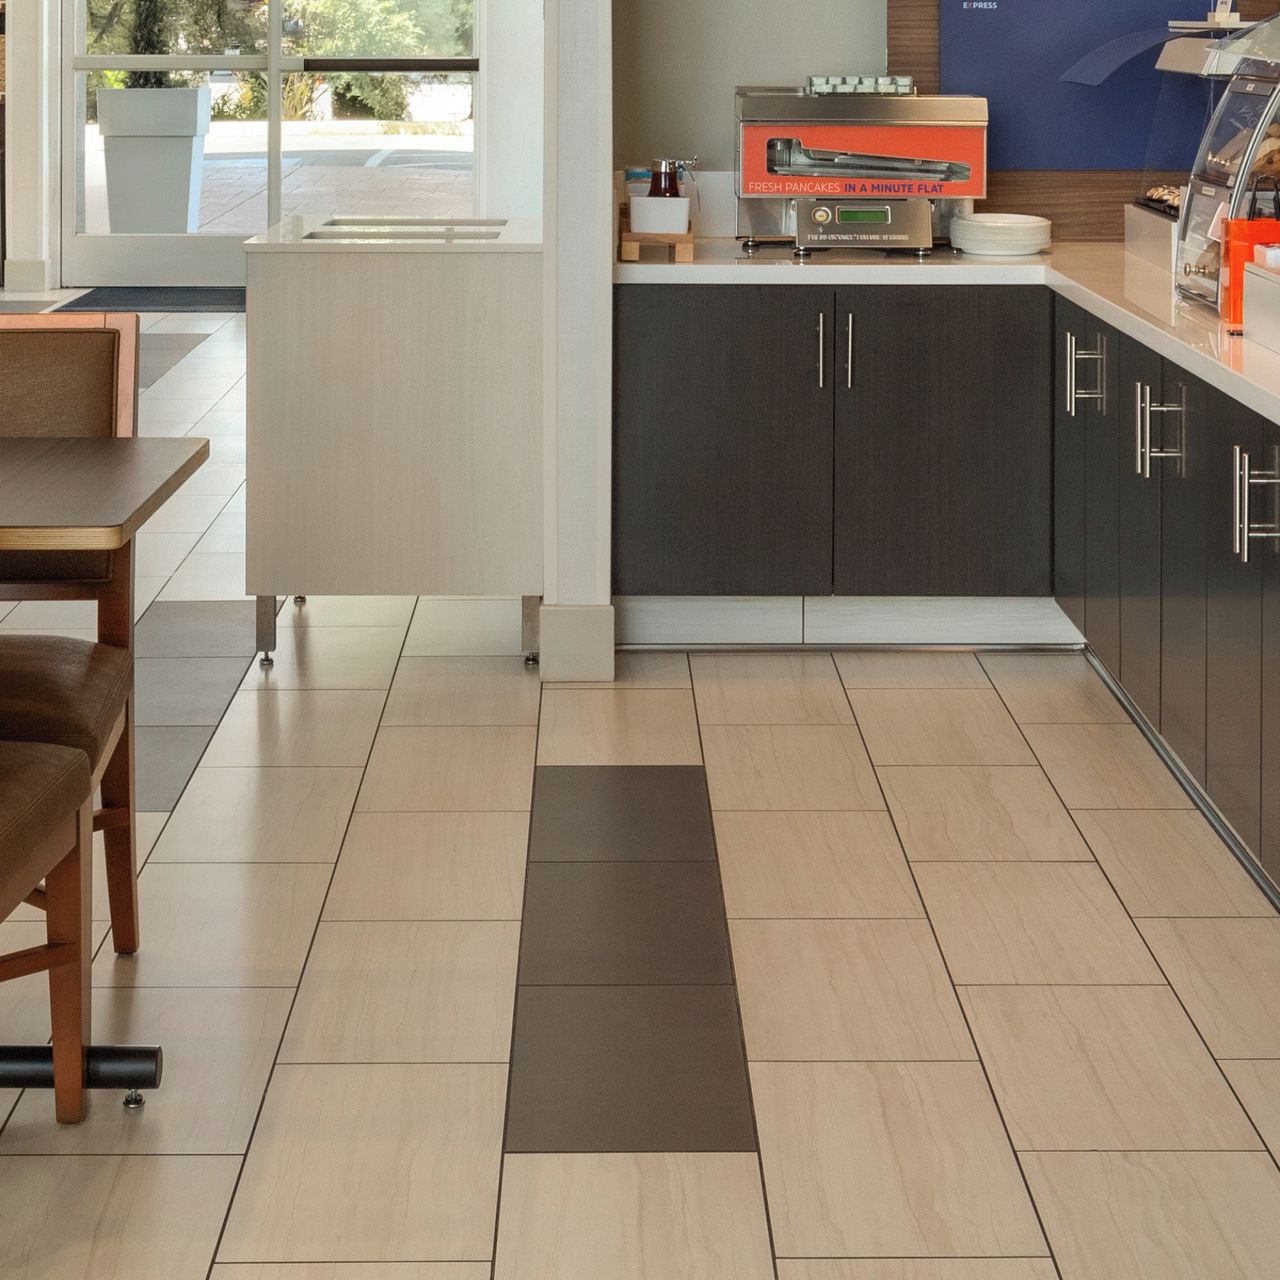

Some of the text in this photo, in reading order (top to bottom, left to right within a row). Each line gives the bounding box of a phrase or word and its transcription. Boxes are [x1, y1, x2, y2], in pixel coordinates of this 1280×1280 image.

[962, 1, 998, 9] EXPRESS
[748, 182, 945, 193] FRESH PANCAKES IN A MINUTE FLAT
